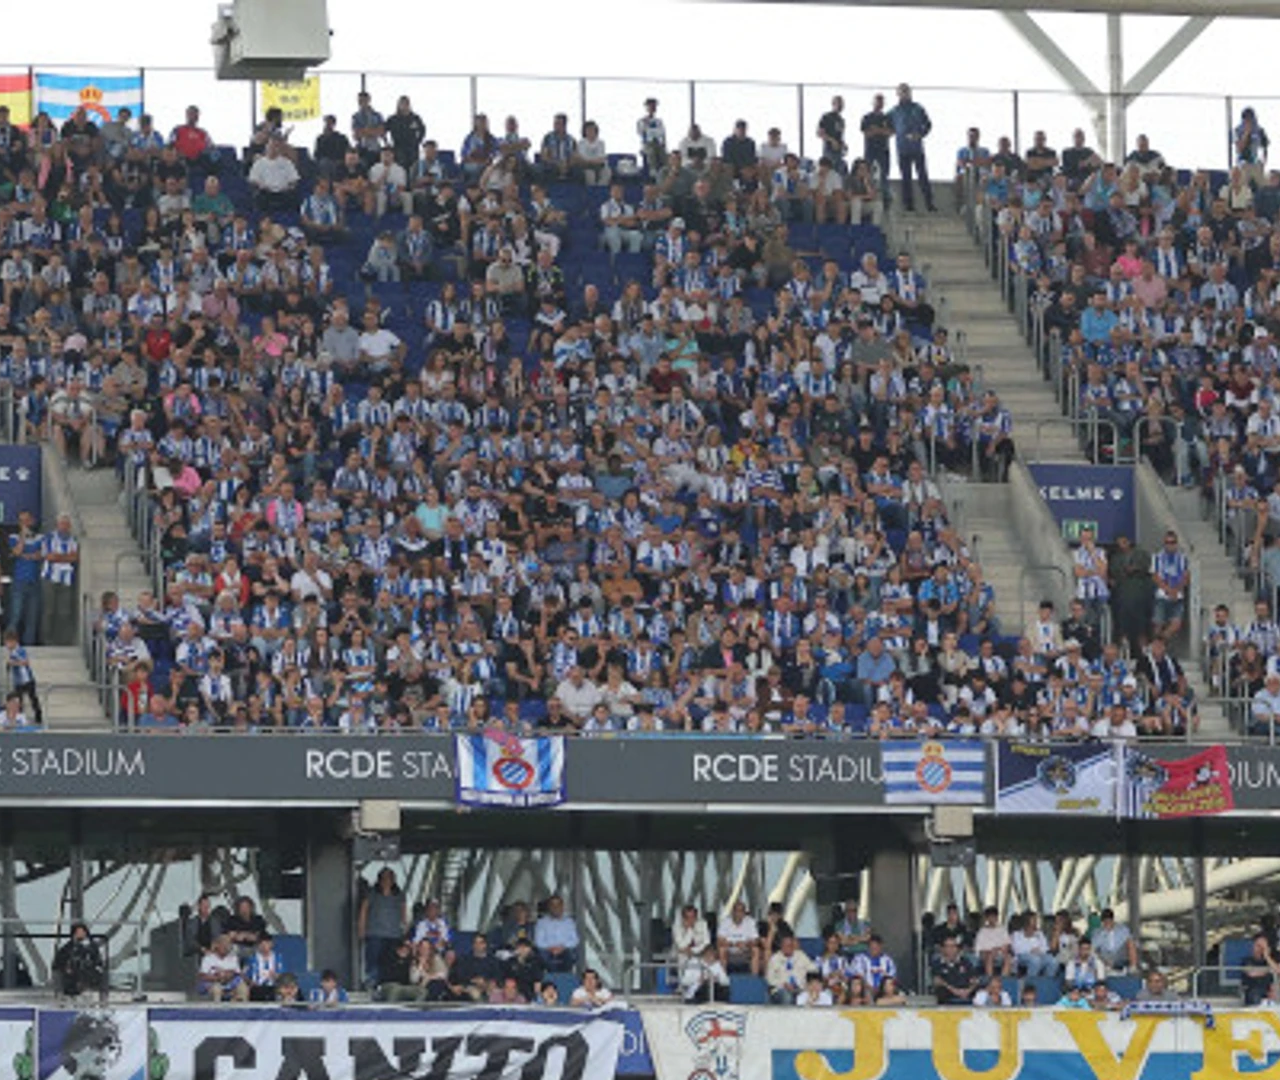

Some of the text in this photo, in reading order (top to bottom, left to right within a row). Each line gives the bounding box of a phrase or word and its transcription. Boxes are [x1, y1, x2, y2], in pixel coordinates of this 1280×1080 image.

[13, 748, 145, 777] STADIUM
[306, 751, 393, 779] RCDE
[694, 754, 885, 784] RCDE STADIU
